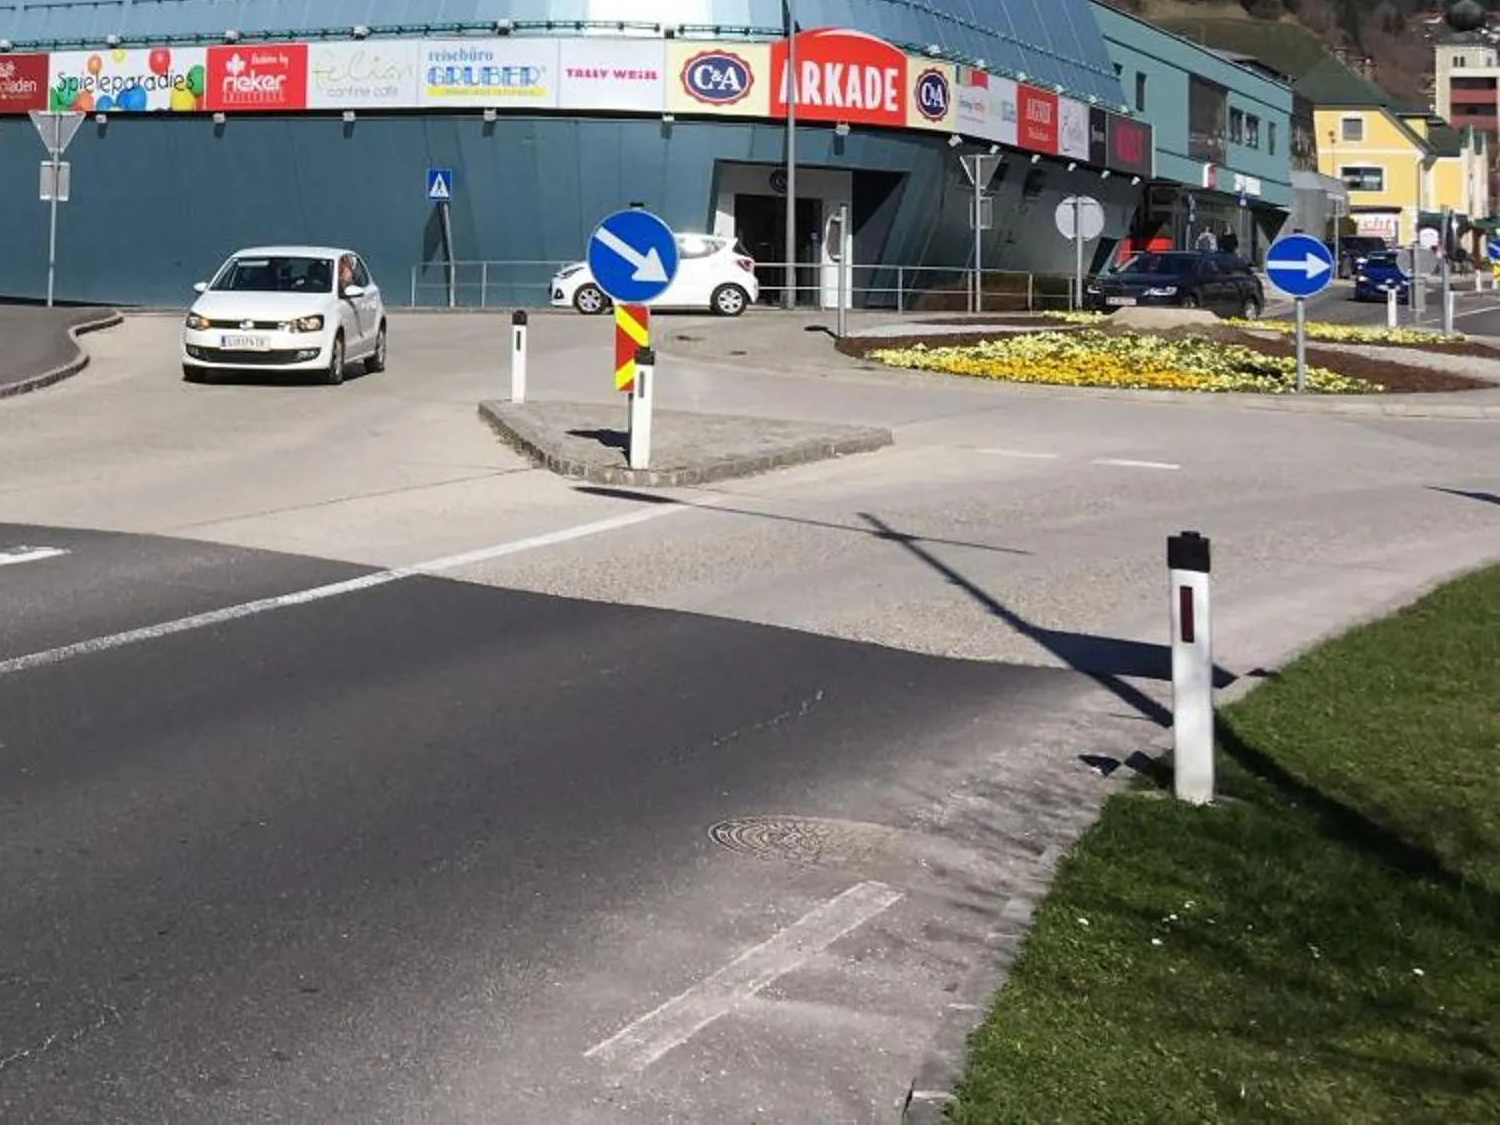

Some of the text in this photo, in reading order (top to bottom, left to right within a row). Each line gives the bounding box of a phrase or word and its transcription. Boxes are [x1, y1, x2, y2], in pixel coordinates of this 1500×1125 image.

[57, 72, 195, 93] Spieleparadies
[222, 69, 287, 92] rieker
[694, 65, 742, 91] C&A
[779, 59, 900, 112] ARKADE
